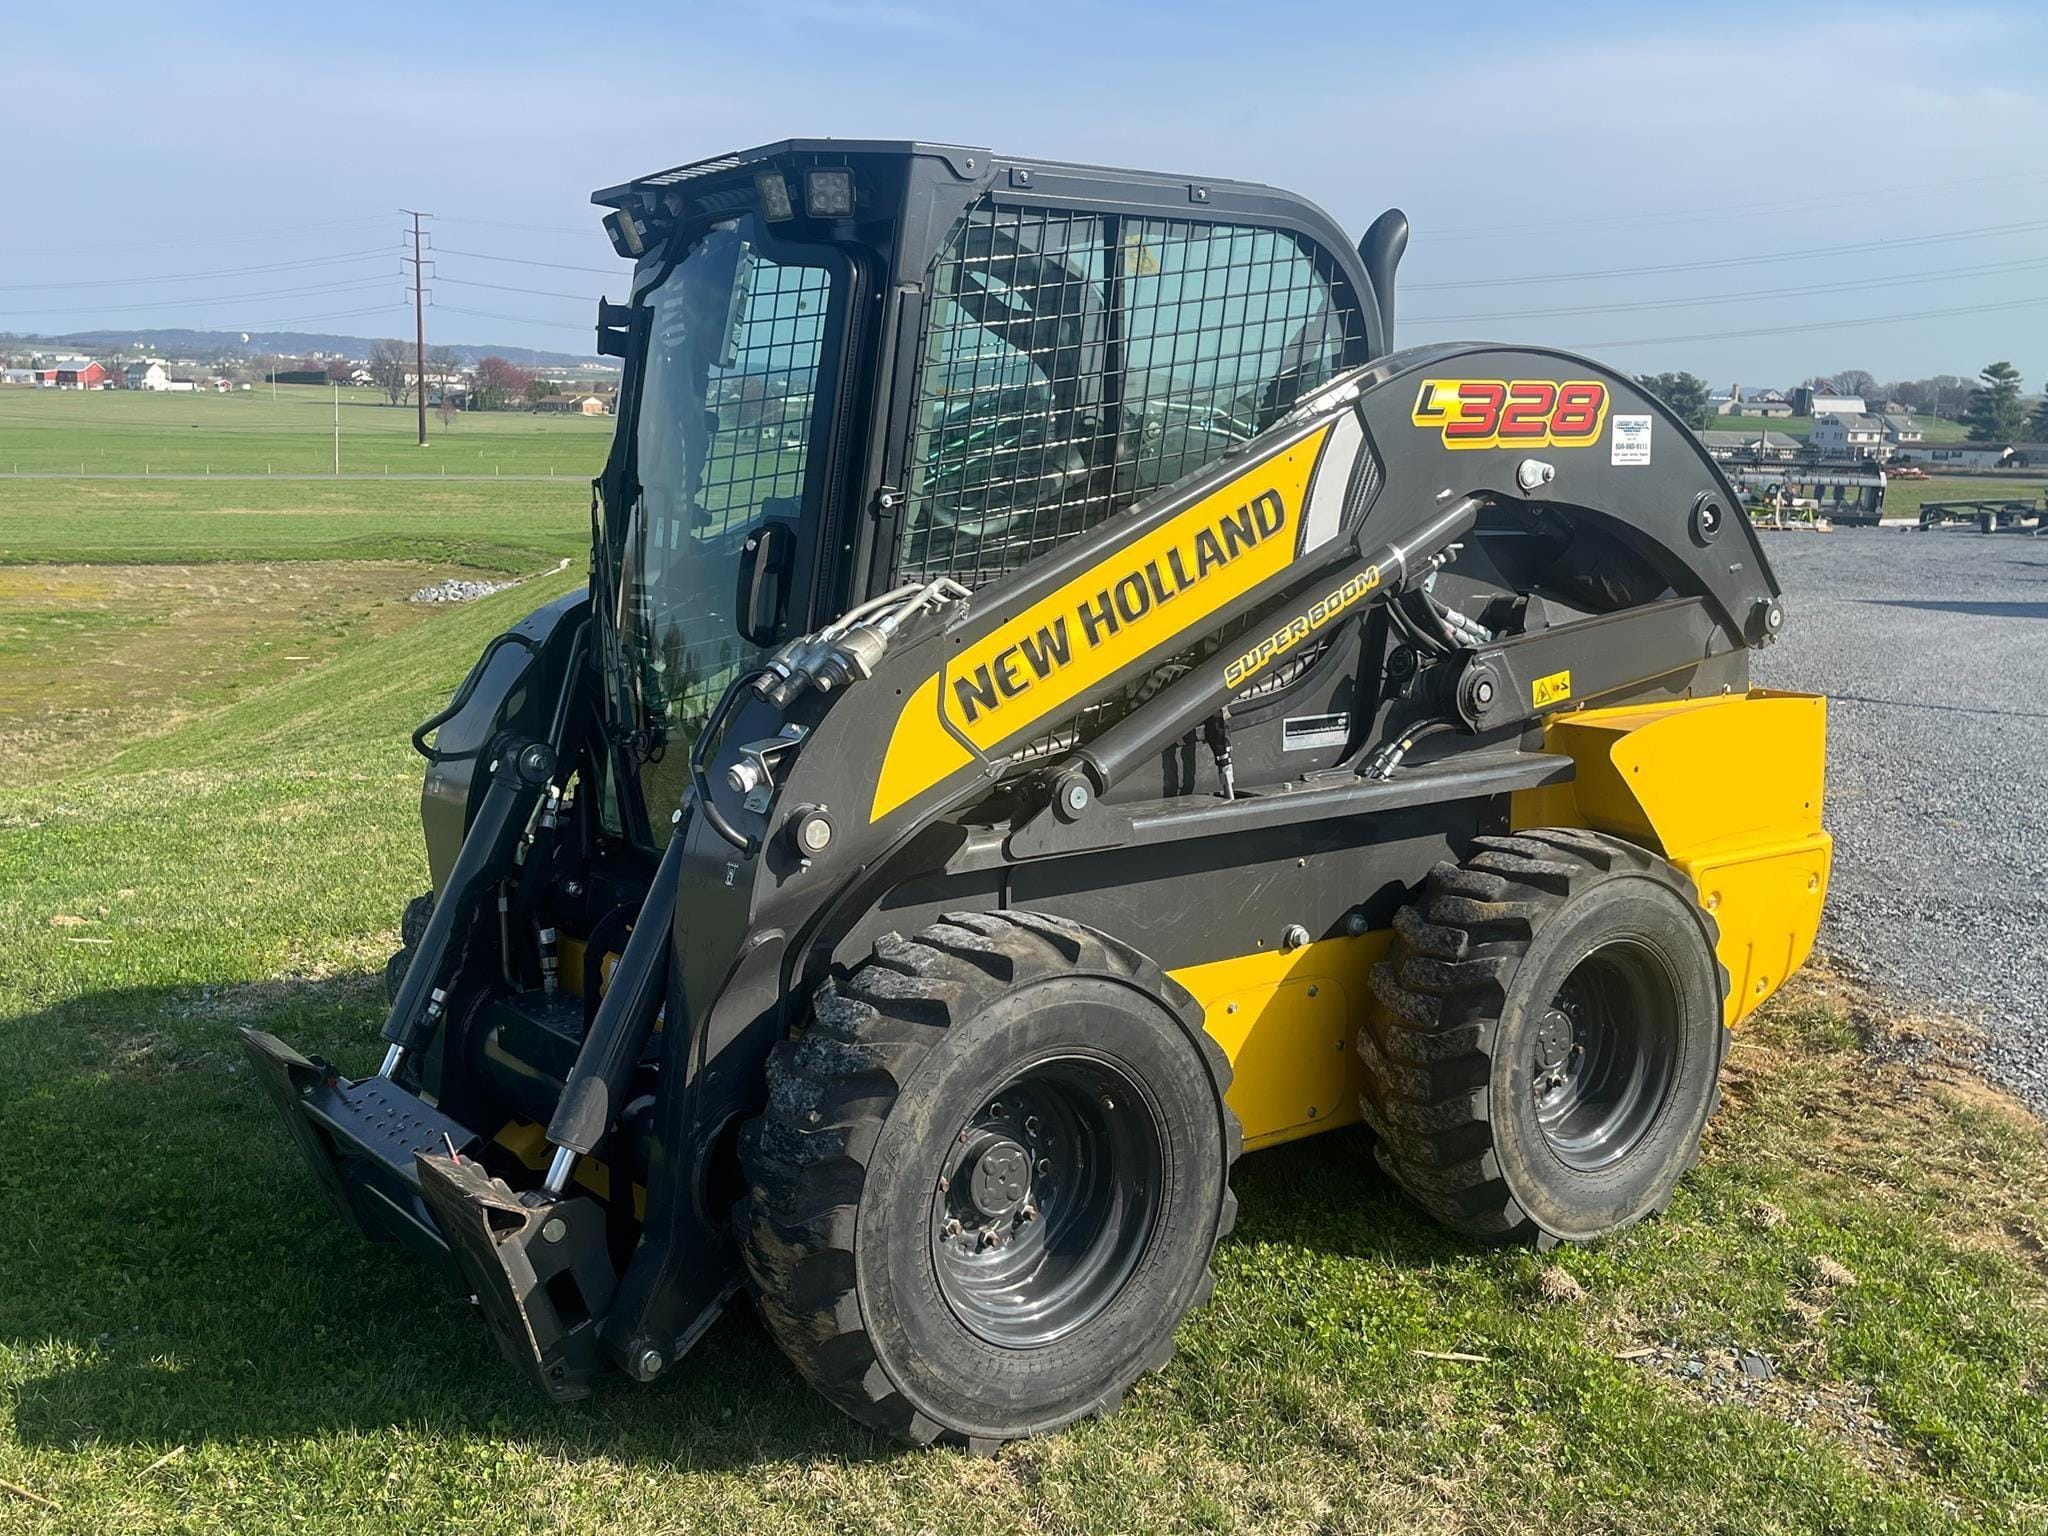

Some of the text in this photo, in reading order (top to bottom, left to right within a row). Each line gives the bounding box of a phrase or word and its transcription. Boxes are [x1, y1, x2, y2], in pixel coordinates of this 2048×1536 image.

[1413, 380, 1609, 446] L328
[953, 488, 1286, 725] NEW HOLLAND
[1224, 566, 1379, 689] SUPER BOOM
